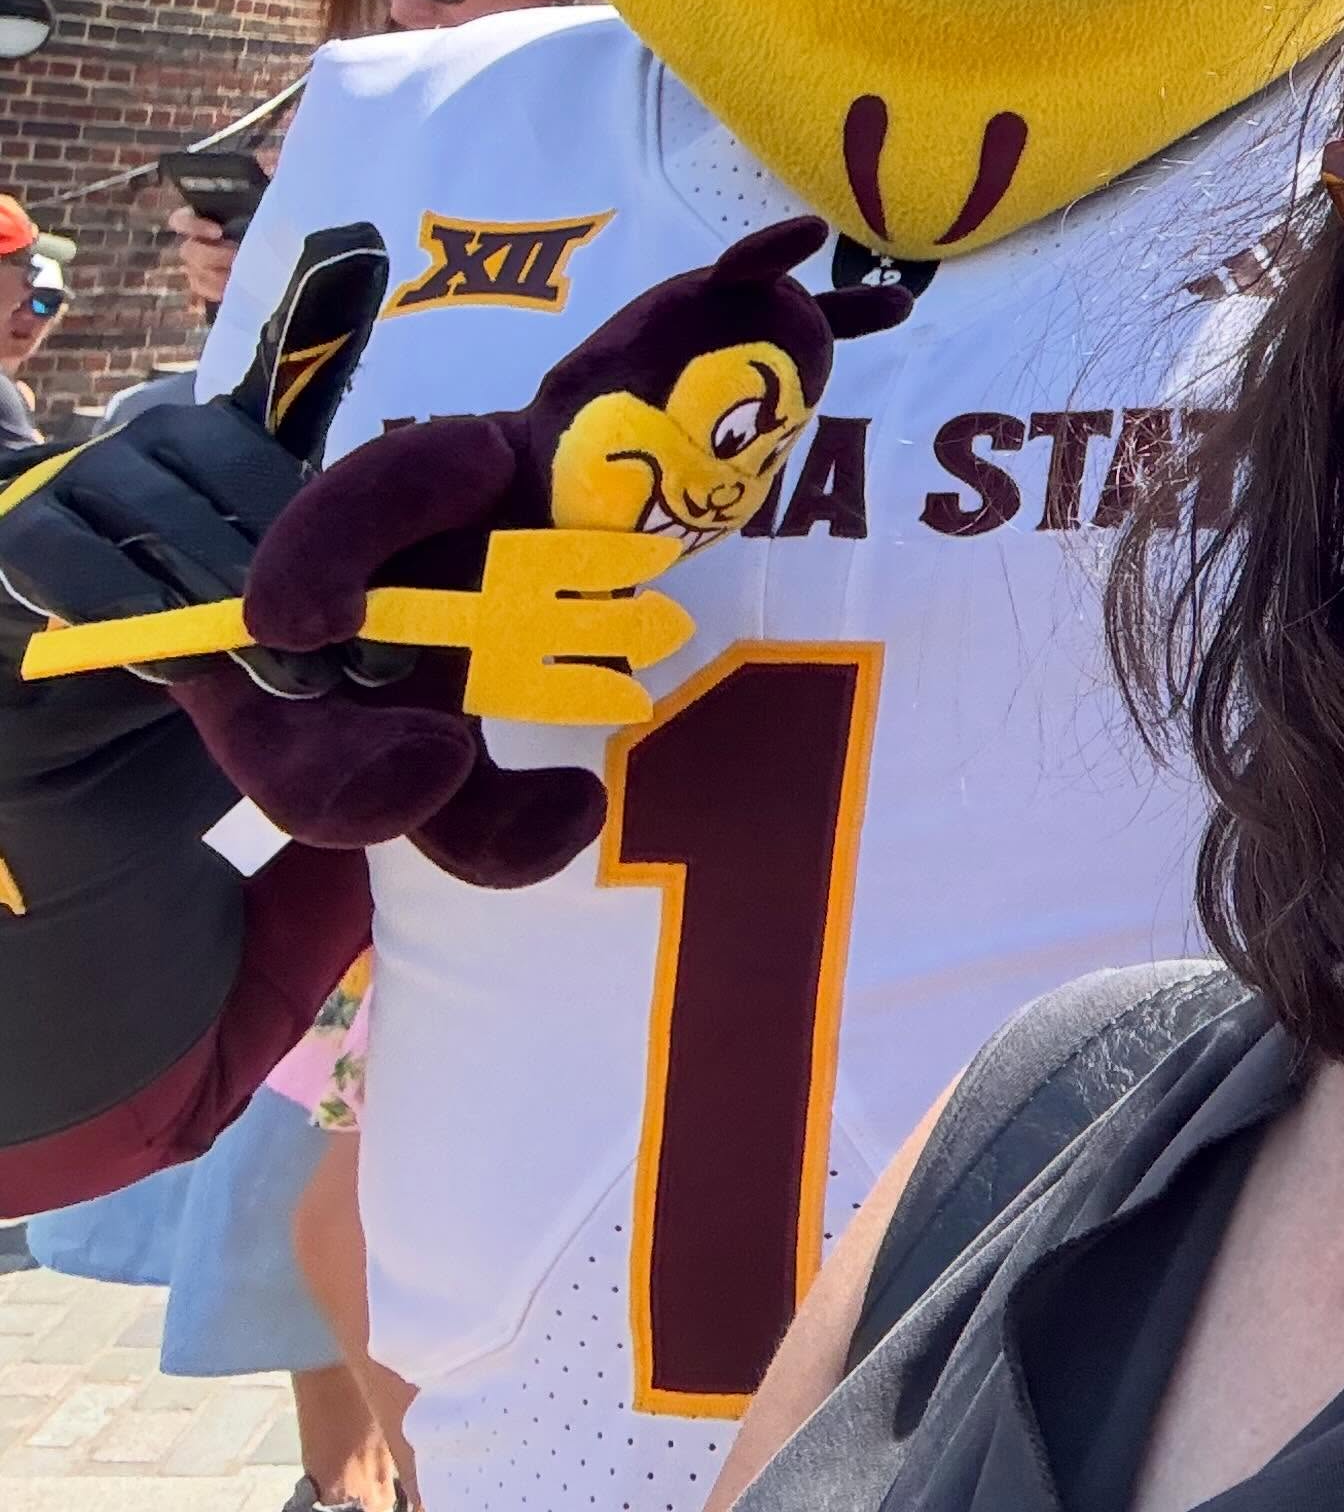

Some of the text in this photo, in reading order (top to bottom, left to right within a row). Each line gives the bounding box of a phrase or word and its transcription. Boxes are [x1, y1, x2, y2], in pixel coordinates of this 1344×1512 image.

[391, 218, 603, 312] XII
[919, 406, 1248, 537] STAT
[596, 638, 886, 1419] 1
